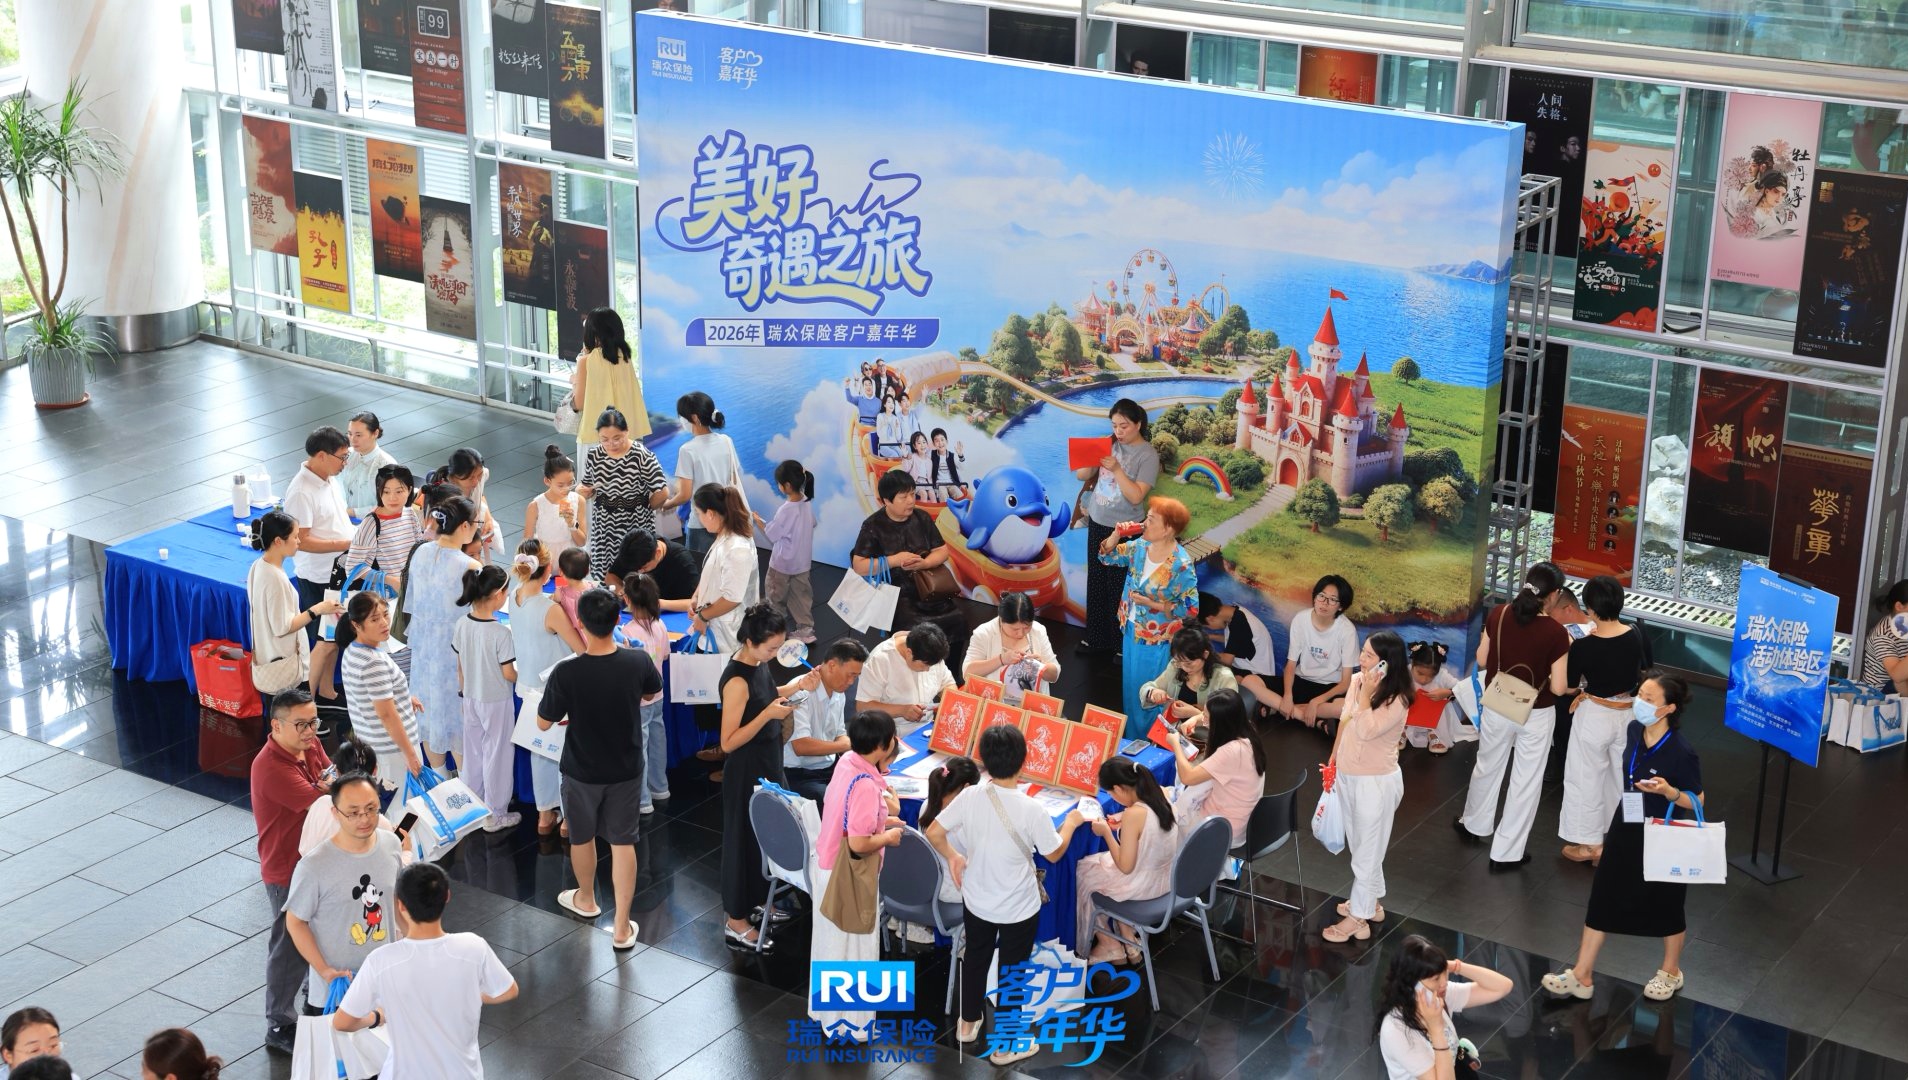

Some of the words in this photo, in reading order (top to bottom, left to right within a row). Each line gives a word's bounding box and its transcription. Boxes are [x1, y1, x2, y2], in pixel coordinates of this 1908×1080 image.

[427, 14, 444, 29] 99
[660, 41, 684, 57] RUI
[718, 47, 746, 65] 客户
[651, 59, 693, 76] 瑞众保险
[718, 65, 758, 90] 嘉年华
[1537, 92, 1563, 107] 人间
[681, 130, 818, 243] 美好
[308, 230, 328, 268] 孔子
[720, 210, 932, 315] 奇遇之旅
[708, 324, 760, 343] 2026年
[767, 323, 917, 342] 瑞众保险客户嘉年华
[1576, 453, 1586, 488] 中秋节
[1741, 615, 1810, 647] 瑞众保险
[1749, 644, 1824, 682] 活动体验区
